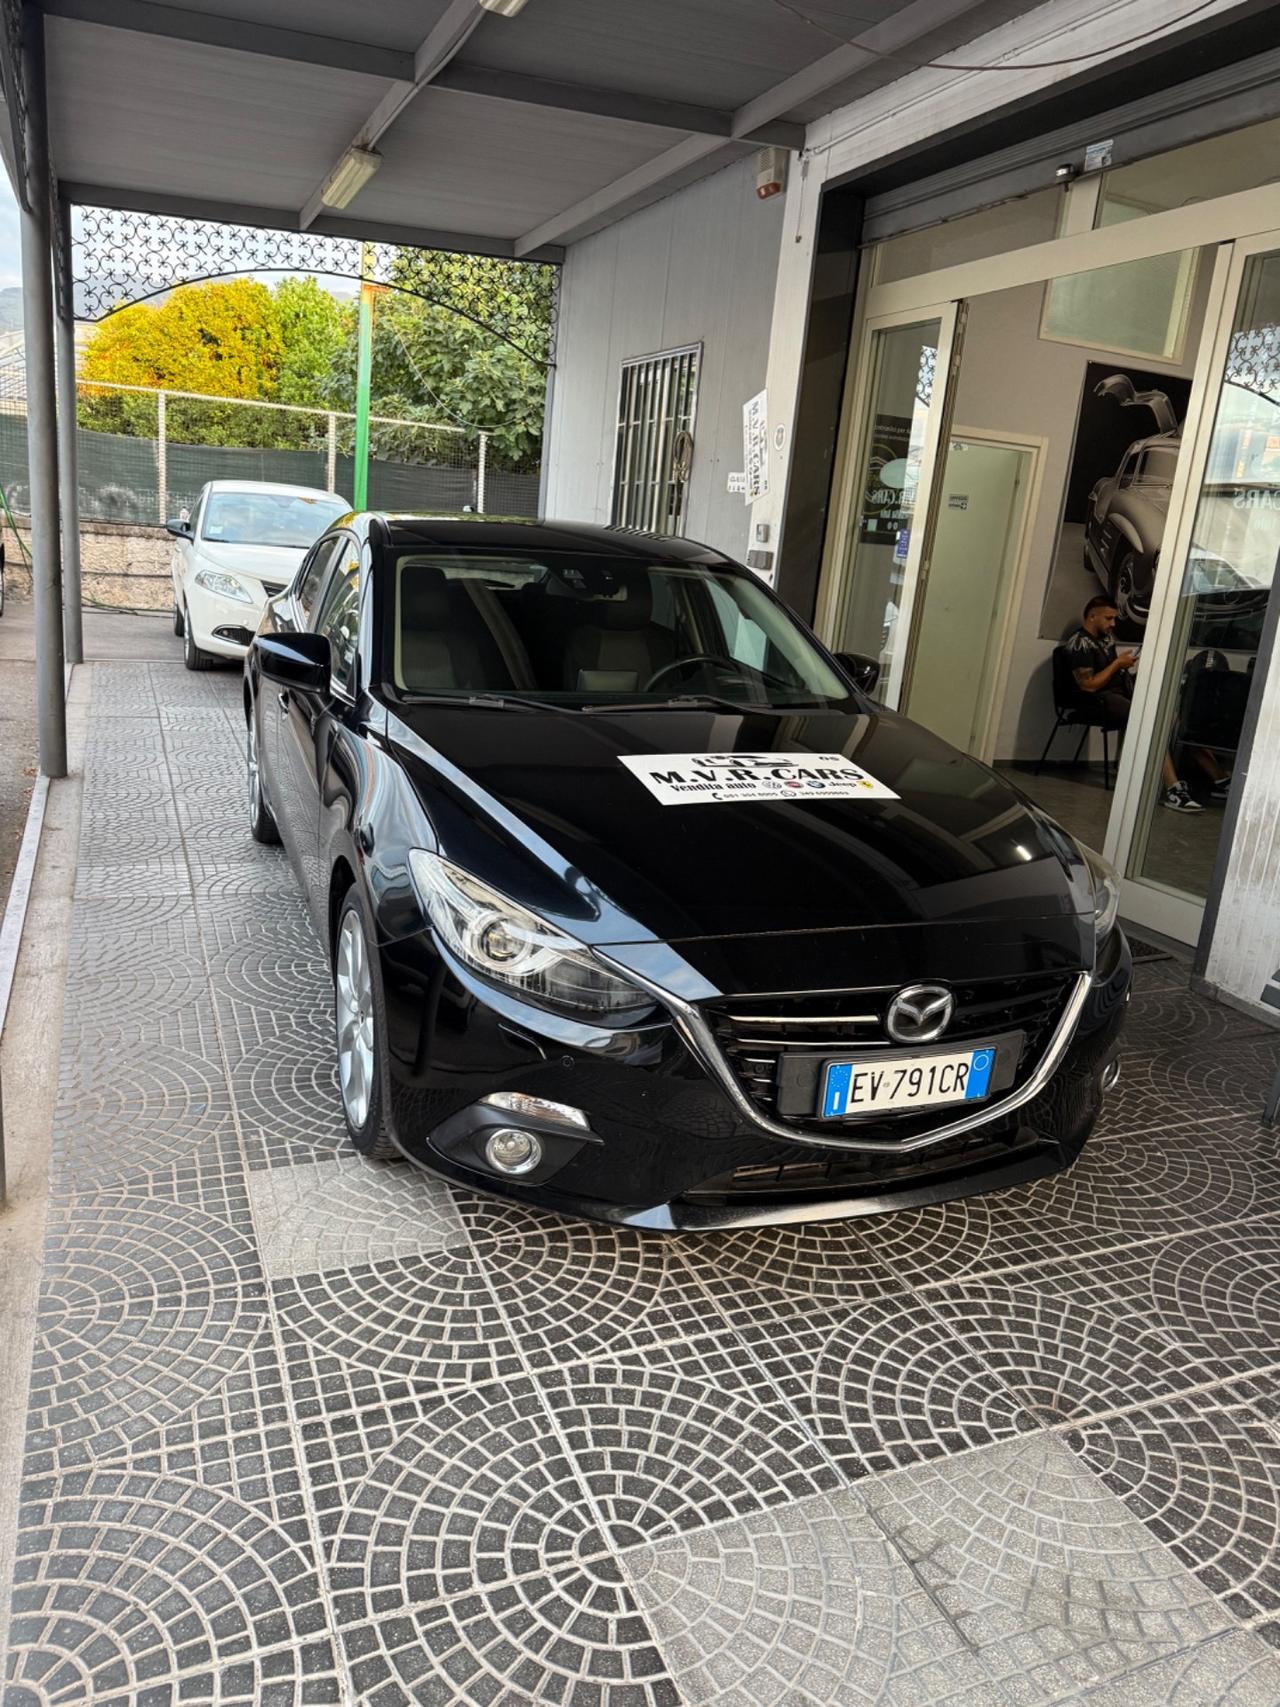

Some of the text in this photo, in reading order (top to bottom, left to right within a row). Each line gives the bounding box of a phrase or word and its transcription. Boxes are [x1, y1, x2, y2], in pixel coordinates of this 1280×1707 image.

[649, 768, 864, 784] M.V.R.CARS
[670, 781, 724, 792] Vendita
[726, 780, 757, 790] auto
[890, 1063, 969, 1099] 791CR
